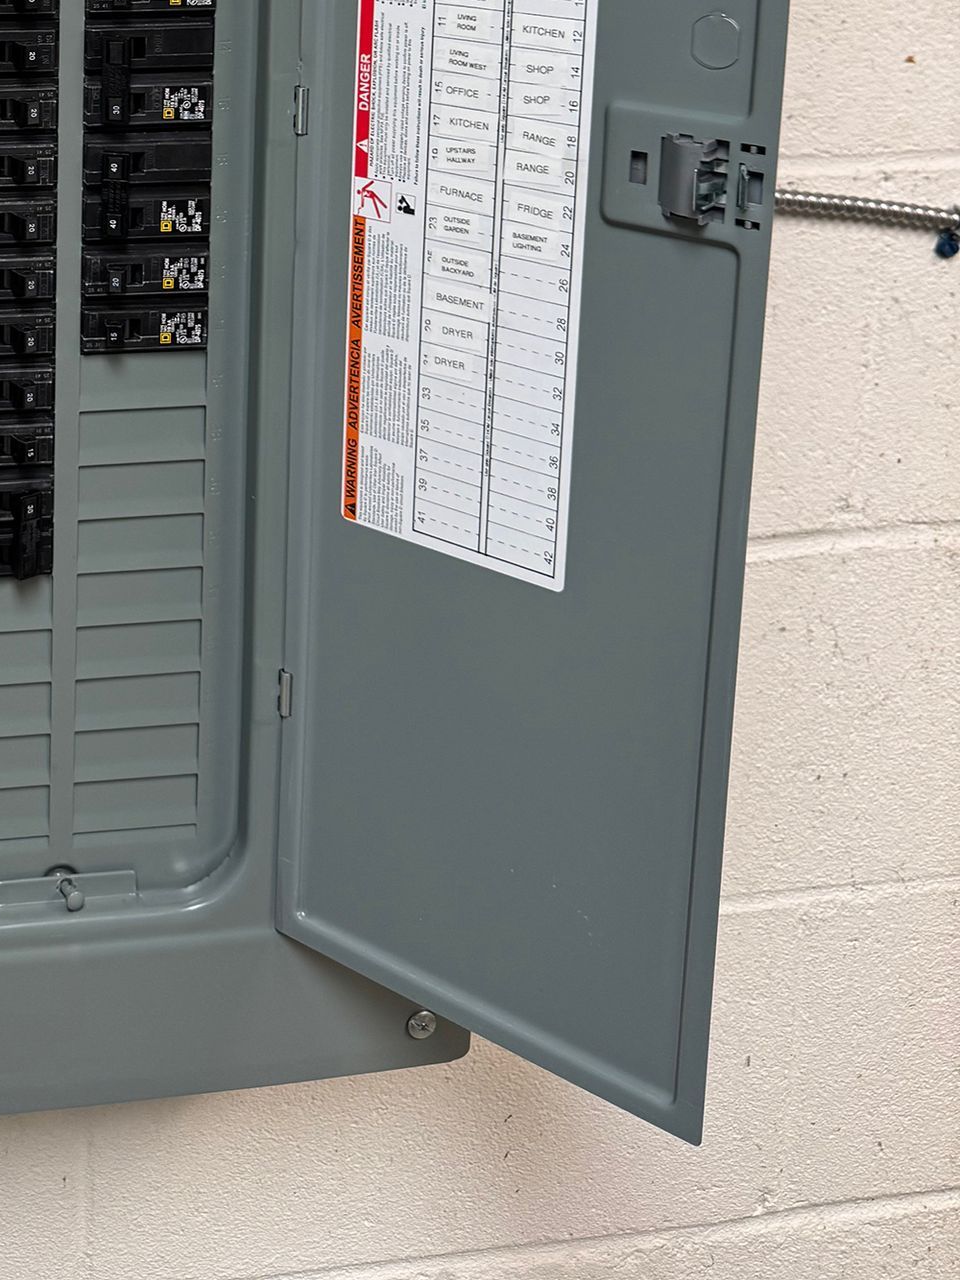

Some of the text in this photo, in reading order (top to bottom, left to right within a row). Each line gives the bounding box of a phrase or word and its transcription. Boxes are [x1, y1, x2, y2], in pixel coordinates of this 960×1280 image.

[438, 16, 446, 26] 11
[457, 14, 477, 22] LIVING
[456, 23, 476, 31] ROOM
[522, 25, 566, 39] KITCHEN
[572, 30, 583, 44] 12
[28, 52, 36, 60] 20
[449, 49, 469, 58] LIVING
[448, 58, 486, 70] ROOM WEST
[526, 64, 554, 74] SHOP
[571, 66, 580, 78] 14
[358, 54, 371, 111] DANGER
[434, 81, 443, 92] 15
[446, 86, 480, 98] OFFICE
[523, 96, 550, 104] SHOP
[112, 106, 120, 115] 30
[569, 100, 579, 113] 16
[30, 108, 38, 118] 20
[433, 114, 440, 126] 17
[449, 118, 489, 130] KITCHEN
[522, 131, 556, 147] RANGE
[566, 136, 576, 148] 18
[28, 166, 34, 175] 20
[110, 163, 118, 173] 40
[516, 162, 550, 174] RANGE
[564, 170, 575, 185] 20
[440, 186, 484, 202] FURNACE
[516, 203, 554, 220] FRIDGE
[562, 206, 573, 220] 22
[110, 220, 116, 230] 40
[428, 216, 438, 230] 23
[443, 216, 470, 225] OUTSIDE
[28, 224, 35, 232] 20
[443, 225, 469, 234] GARDEN
[512, 232, 548, 243] BASEMENT
[512, 242, 542, 252] LIGHTING
[560, 244, 570, 258] 24
[442, 256, 470, 267] OUTSIDE
[352, 218, 365, 328] AVERTISSEMENT
[441, 266, 474, 278] BACKYARD
[28, 280, 34, 290] 20
[112, 278, 120, 287] 20
[558, 278, 568, 293] 26
[436, 292, 484, 310] BASEMENT
[556, 318, 566, 332] 28
[110, 332, 118, 341] 15
[442, 326, 473, 340] DRYER
[28, 337, 34, 346] 20
[434, 356, 465, 370] DRYER
[554, 352, 564, 365] 30
[348, 338, 360, 430] ADVERTENCIA
[26, 393, 34, 402] 20
[422, 386, 431, 400] 33
[552, 387, 562, 400] 32
[420, 418, 430, 432] 35
[551, 422, 560, 436] 34
[28, 448, 34, 457] 15
[420, 448, 428, 462] 37
[345, 438, 358, 498] WARNING
[548, 456, 558, 470] 36
[418, 478, 428, 492] 39
[546, 487, 557, 501] 38
[27, 504, 34, 514] 30
[417, 510, 426, 524] 41
[545, 518, 555, 532] 40
[544, 550, 553, 565] 42
